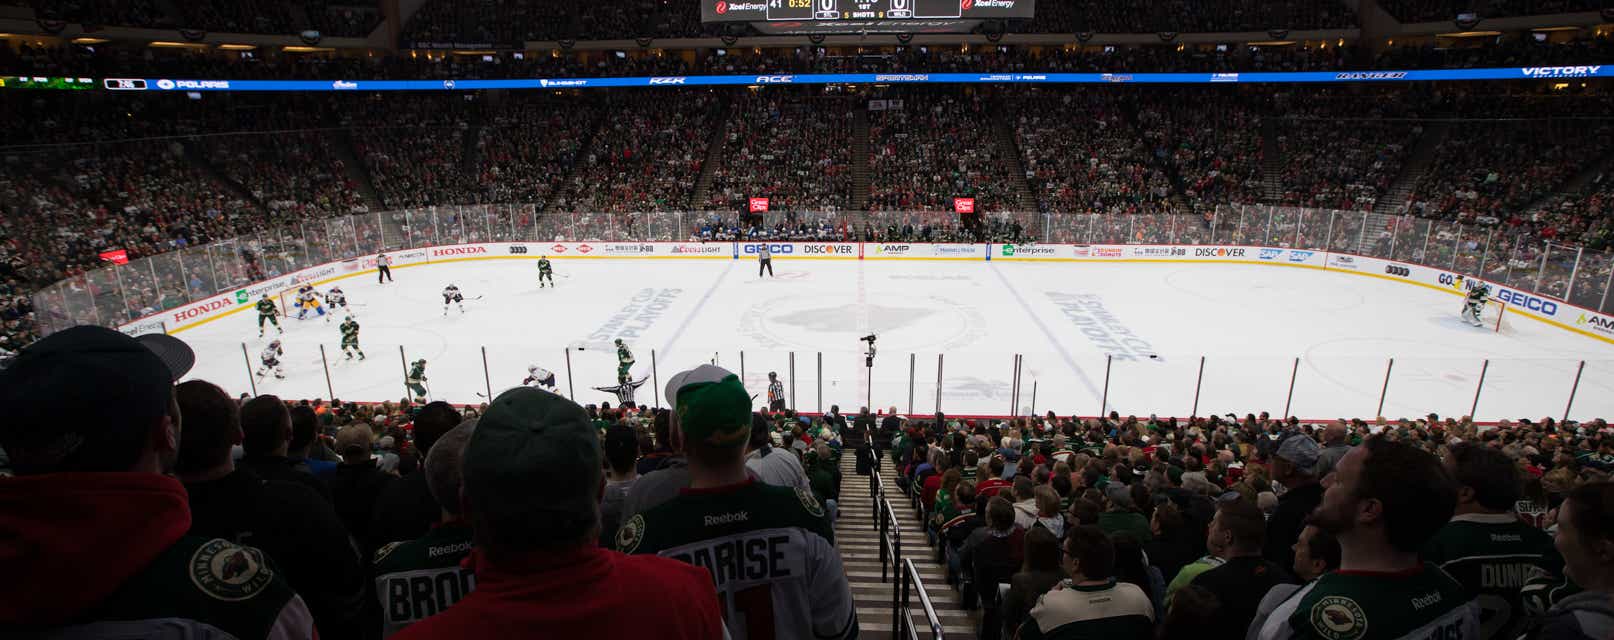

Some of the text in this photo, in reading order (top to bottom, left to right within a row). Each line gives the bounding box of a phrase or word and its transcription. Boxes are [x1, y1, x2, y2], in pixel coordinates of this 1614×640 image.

[1521, 65, 1601, 75] VICTORY
[756, 75, 793, 83] ACE
[176, 80, 229, 89] POLARIS
[433, 246, 487, 257] HONDA
[804, 245, 853, 254] DISCOVER
[1195, 247, 1245, 257] DISCOVER
[1498, 288, 1557, 317] GEICO
[174, 297, 232, 323] HONDA
[703, 511, 749, 527] Reebok
[428, 540, 472, 558] Reebok
